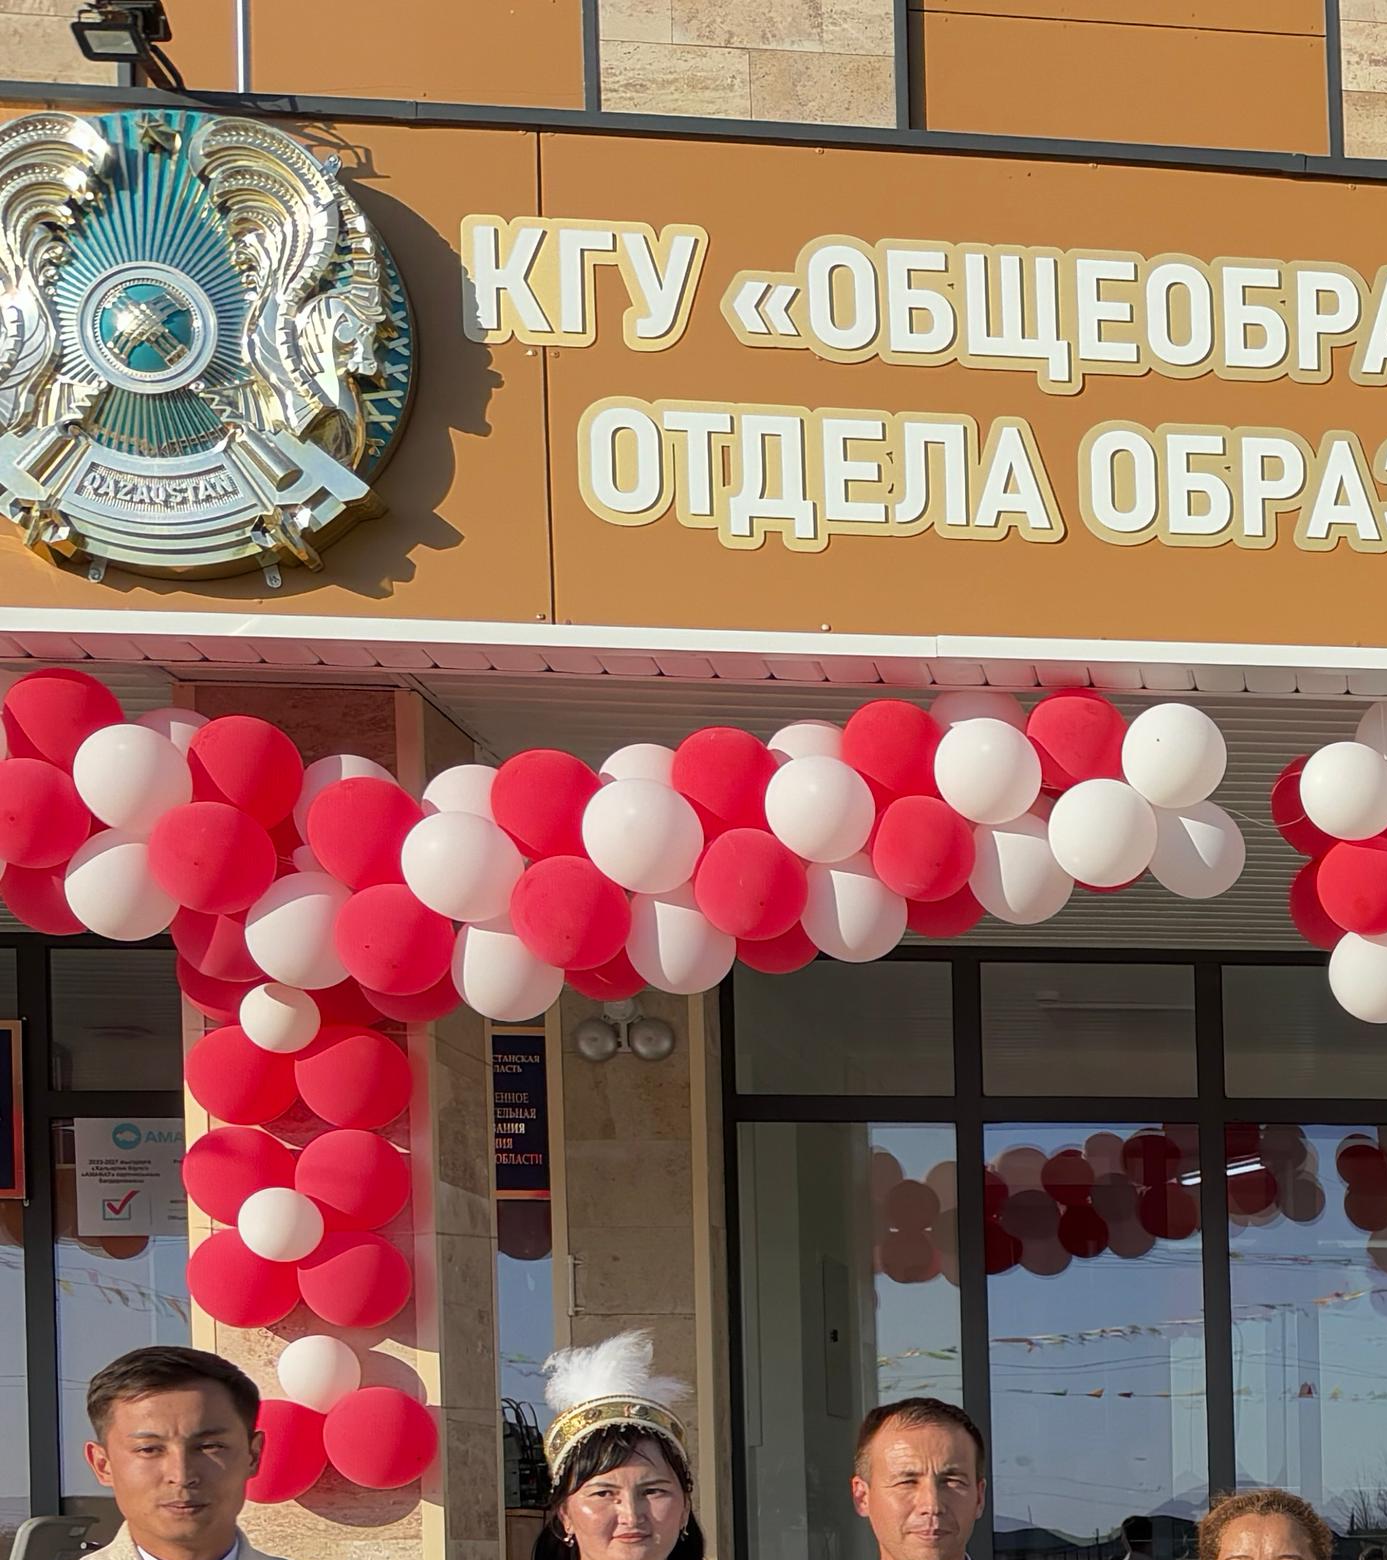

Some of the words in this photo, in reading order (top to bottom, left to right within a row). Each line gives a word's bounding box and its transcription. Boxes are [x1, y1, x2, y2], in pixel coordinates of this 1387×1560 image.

[465, 222, 697, 339] КГУ
[83, 471, 233, 504] QAZAQSTAN
[587, 405, 1052, 540] ОТДЕЛА
